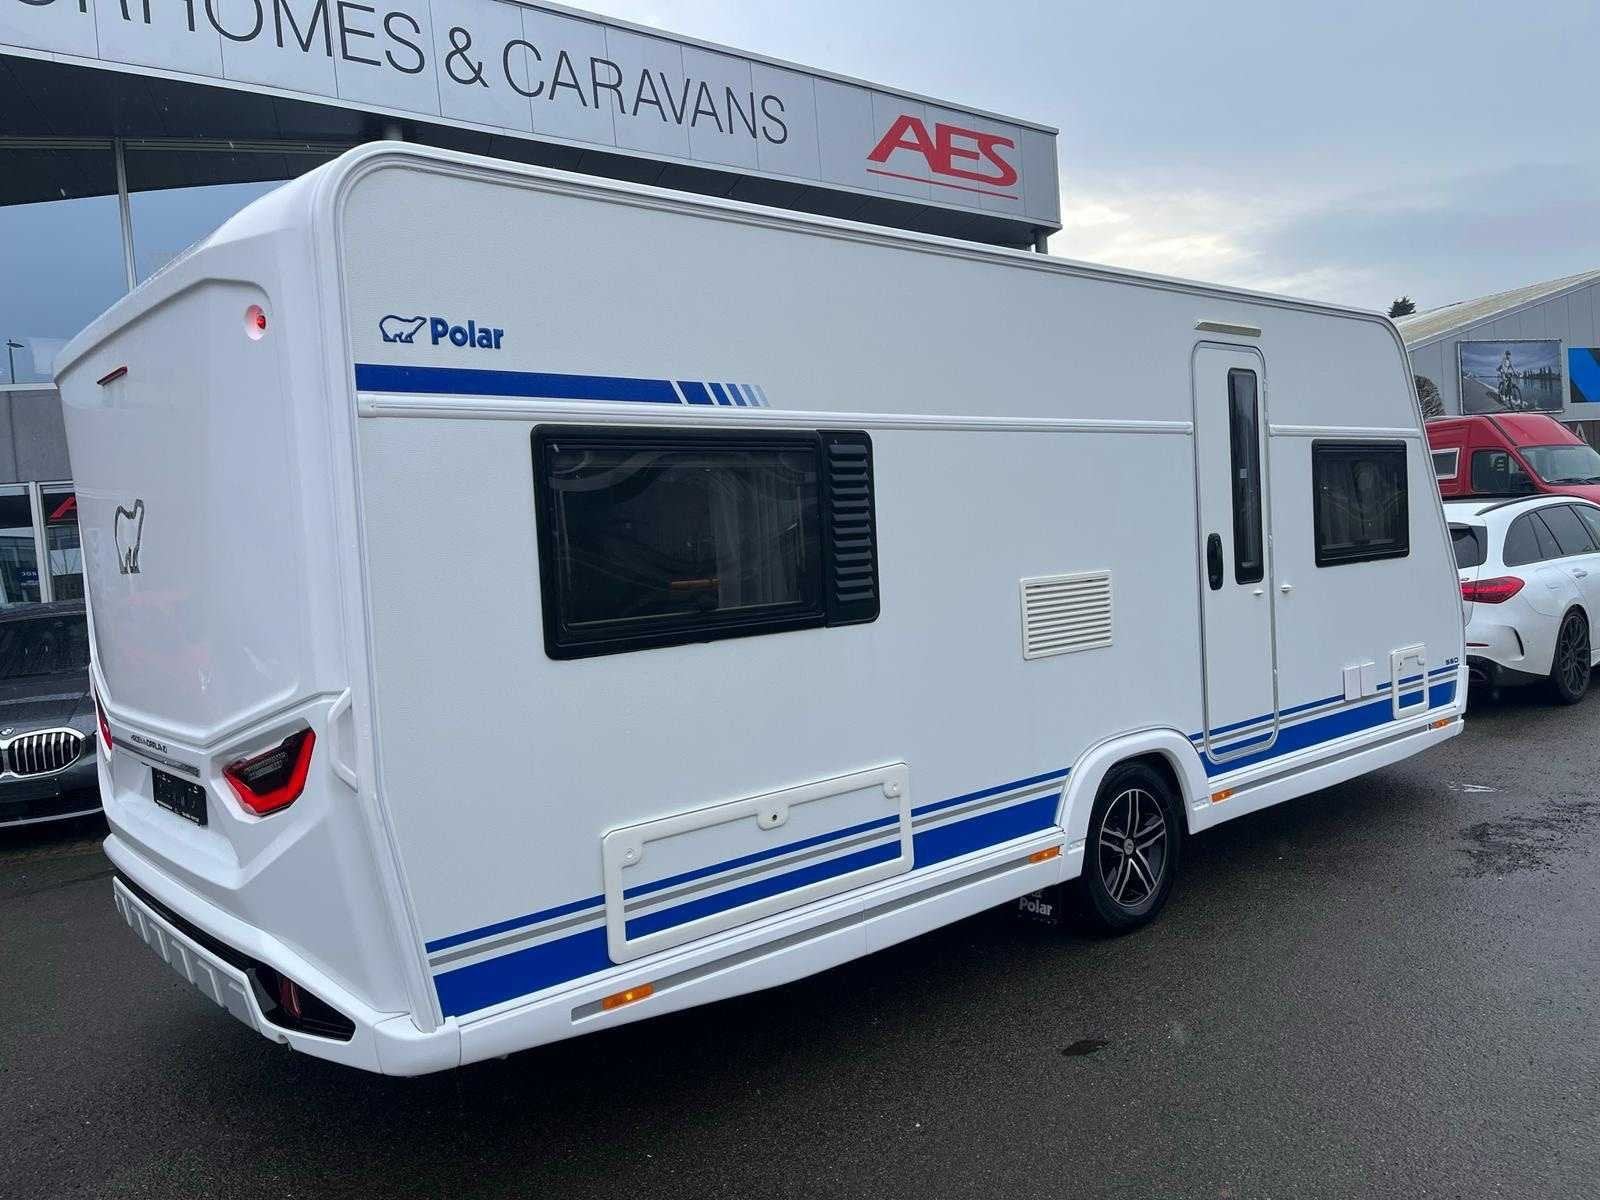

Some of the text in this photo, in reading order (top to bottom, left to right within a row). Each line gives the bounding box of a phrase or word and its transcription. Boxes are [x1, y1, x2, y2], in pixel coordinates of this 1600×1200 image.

[18, 0, 788, 145] OMES & CARAVANS
[866, 114, 1018, 187] AES
[430, 316, 504, 349] Polar
[1019, 896, 1053, 916] Polar
